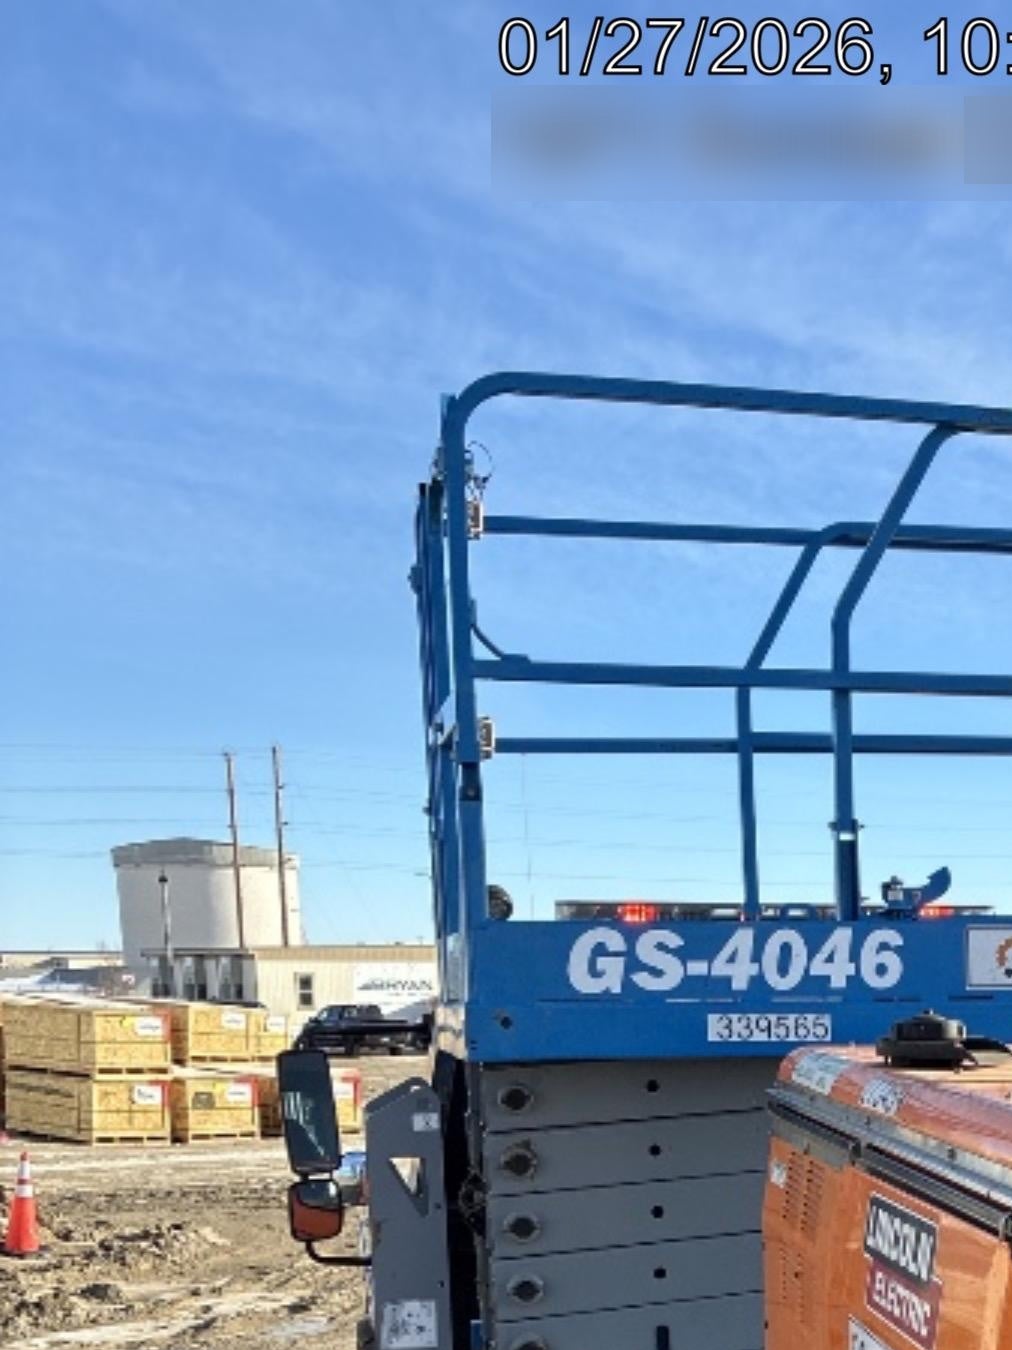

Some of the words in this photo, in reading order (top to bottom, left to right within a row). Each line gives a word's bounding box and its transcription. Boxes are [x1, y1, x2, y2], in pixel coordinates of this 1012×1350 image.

[567, 926, 904, 995] GS-4046
[866, 1204, 934, 1282] LINCOLN
[873, 1271, 931, 1338] ELECTRIC
